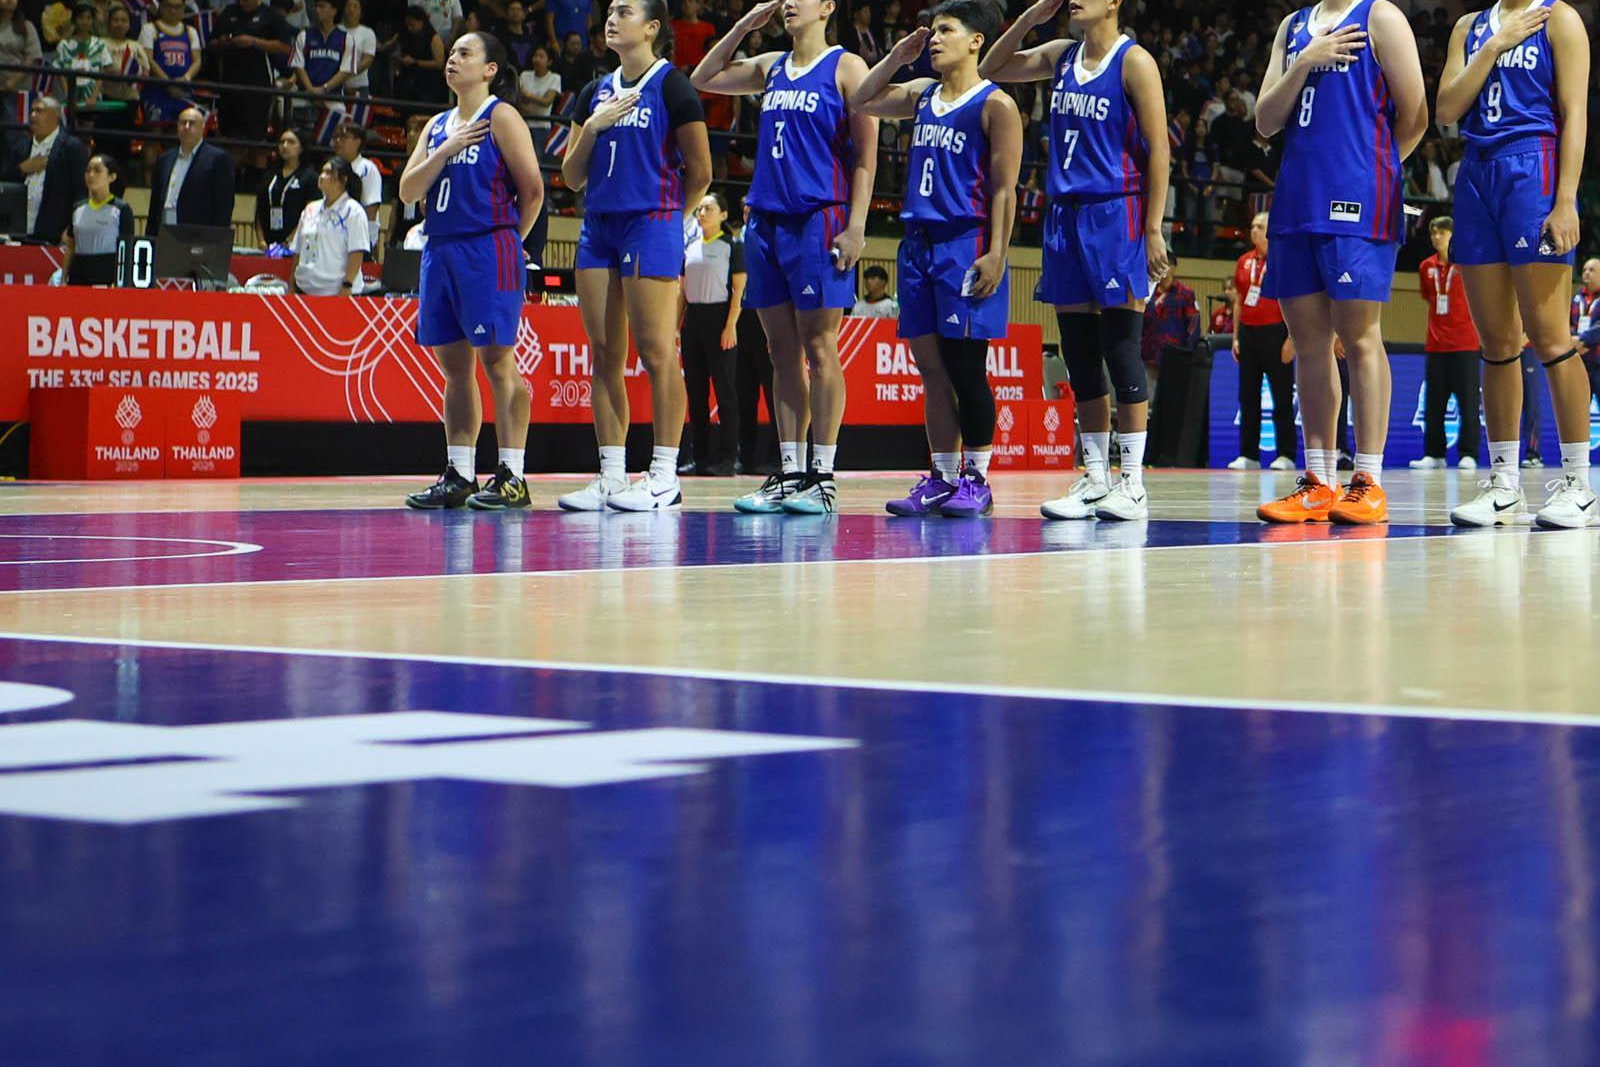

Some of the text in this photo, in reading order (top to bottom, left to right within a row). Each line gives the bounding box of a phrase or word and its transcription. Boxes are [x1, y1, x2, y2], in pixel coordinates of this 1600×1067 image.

[1299, 86, 1315, 127] 8
[1487, 81, 1502, 123] 9
[771, 121, 785, 159] 3
[1063, 129, 1079, 170] 7
[607, 140, 617, 177] 1
[436, 177, 451, 213] 0
[919, 157, 934, 197] 6
[133, 240, 153, 289] 0
[27, 315, 260, 361] BASKETBALL
[876, 342, 1024, 377] BASALL
[27, 368, 259, 393] THE 33rd SEA GAMES 2025
[550, 379, 592, 407] 202
[875, 383, 898, 401] THE
[994, 386, 1024, 401] 2025
[95, 446, 160, 460] THAILAND
[172, 446, 235, 460] THAILAND
[992, 444, 1025, 456] HAILAND
[1032, 444, 1071, 456] THAILAND
